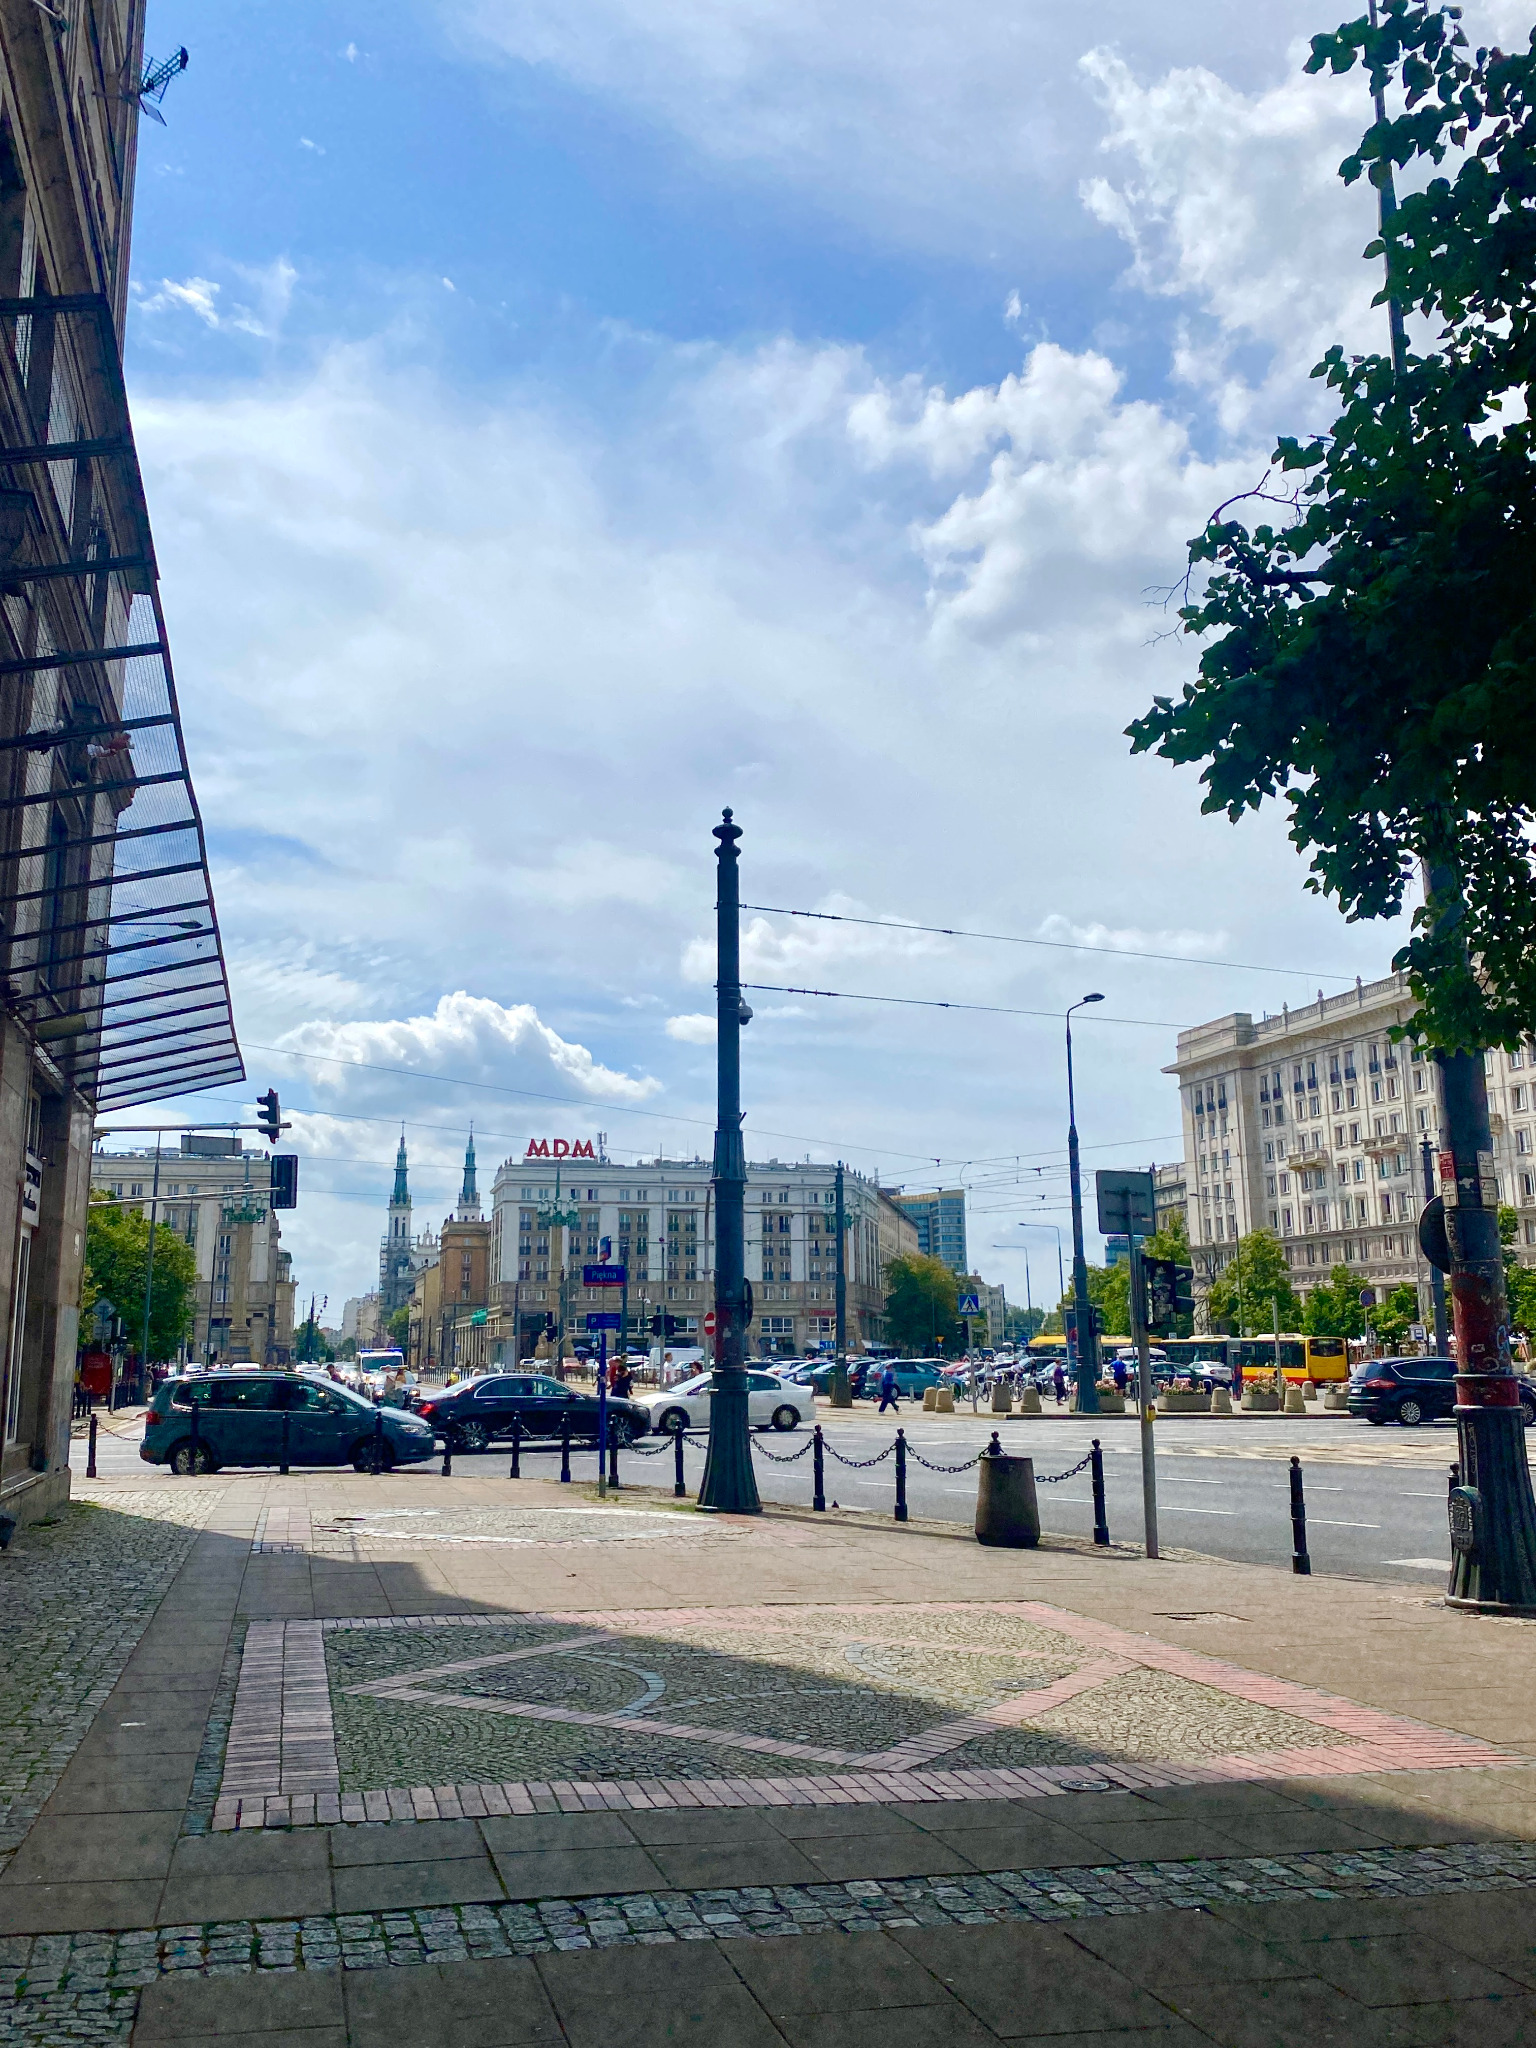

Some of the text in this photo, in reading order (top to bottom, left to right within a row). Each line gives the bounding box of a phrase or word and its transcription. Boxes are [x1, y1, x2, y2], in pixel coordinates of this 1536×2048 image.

[526, 1138, 596, 1159] MDM
[591, 1270, 617, 1281] Piękna
[591, 1317, 597, 1325] P
